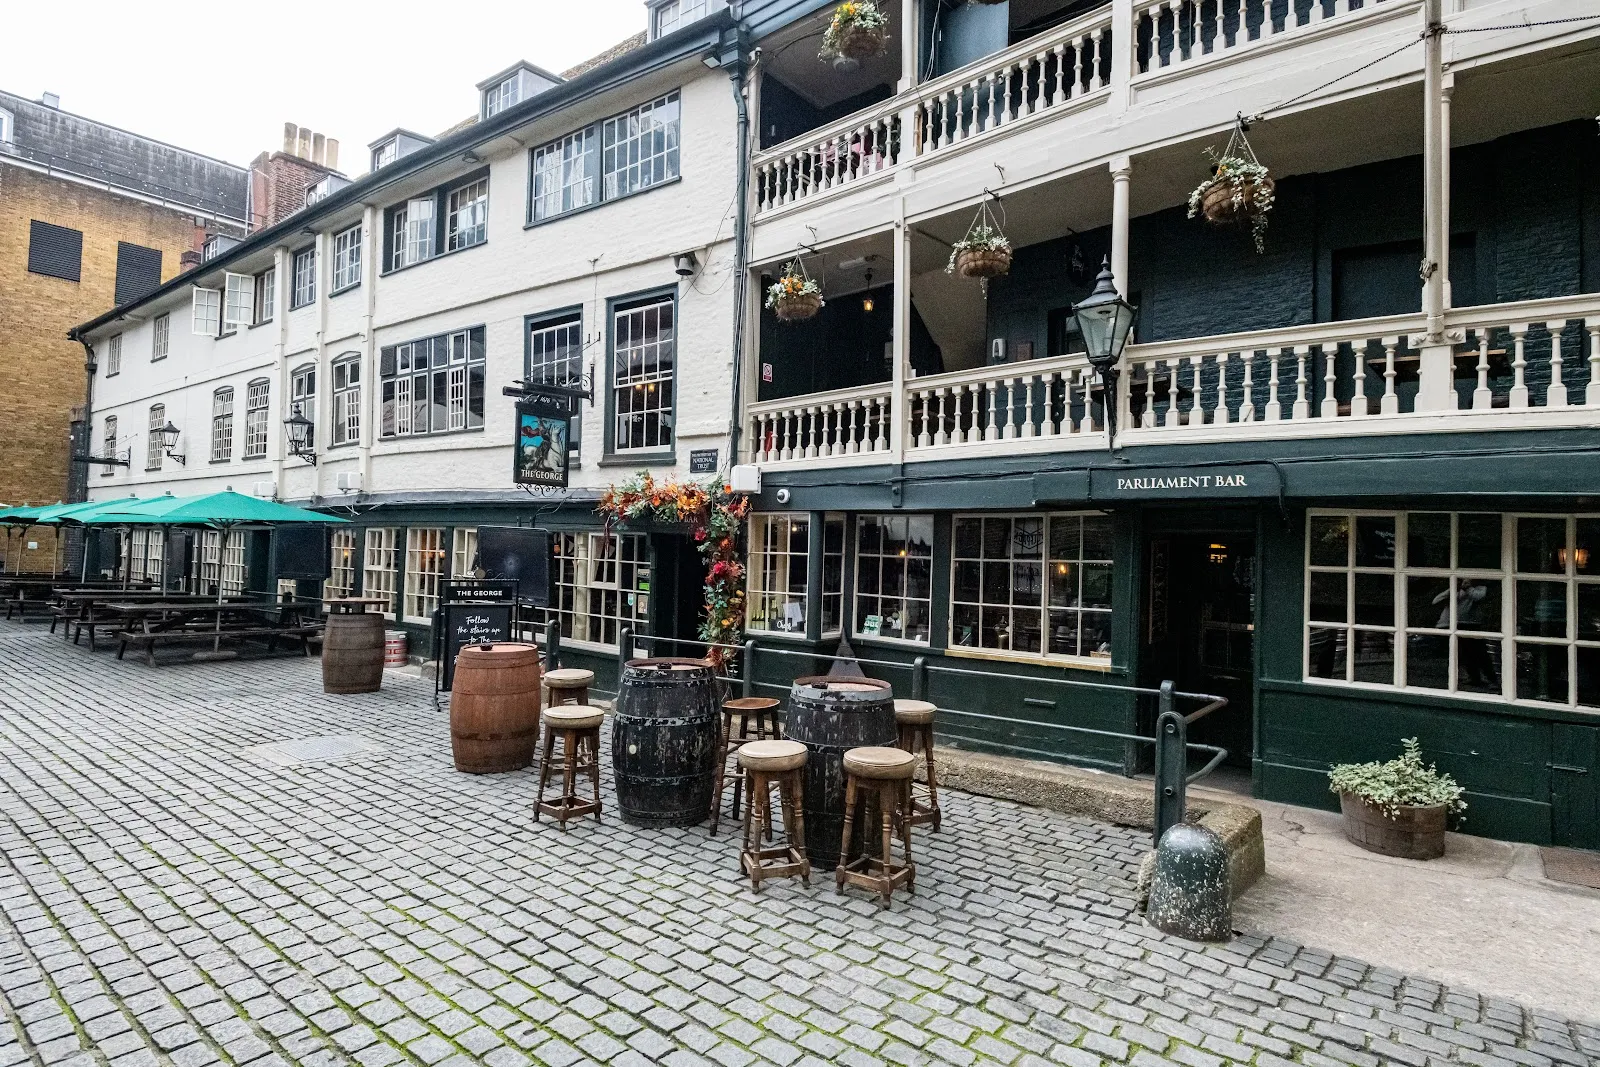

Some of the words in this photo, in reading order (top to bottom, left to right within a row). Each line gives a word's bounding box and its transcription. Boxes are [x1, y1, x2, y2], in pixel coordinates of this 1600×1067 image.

[521, 469, 534, 478] THE
[536, 470, 563, 480] GEORGE
[1117, 475, 1211, 490] PARLIAMENT
[1215, 474, 1248, 487] BAR
[466, 616, 490, 624] Follow
[457, 626, 468, 634] the
[470, 625, 490, 634] stairs
[469, 636, 478, 644] to
